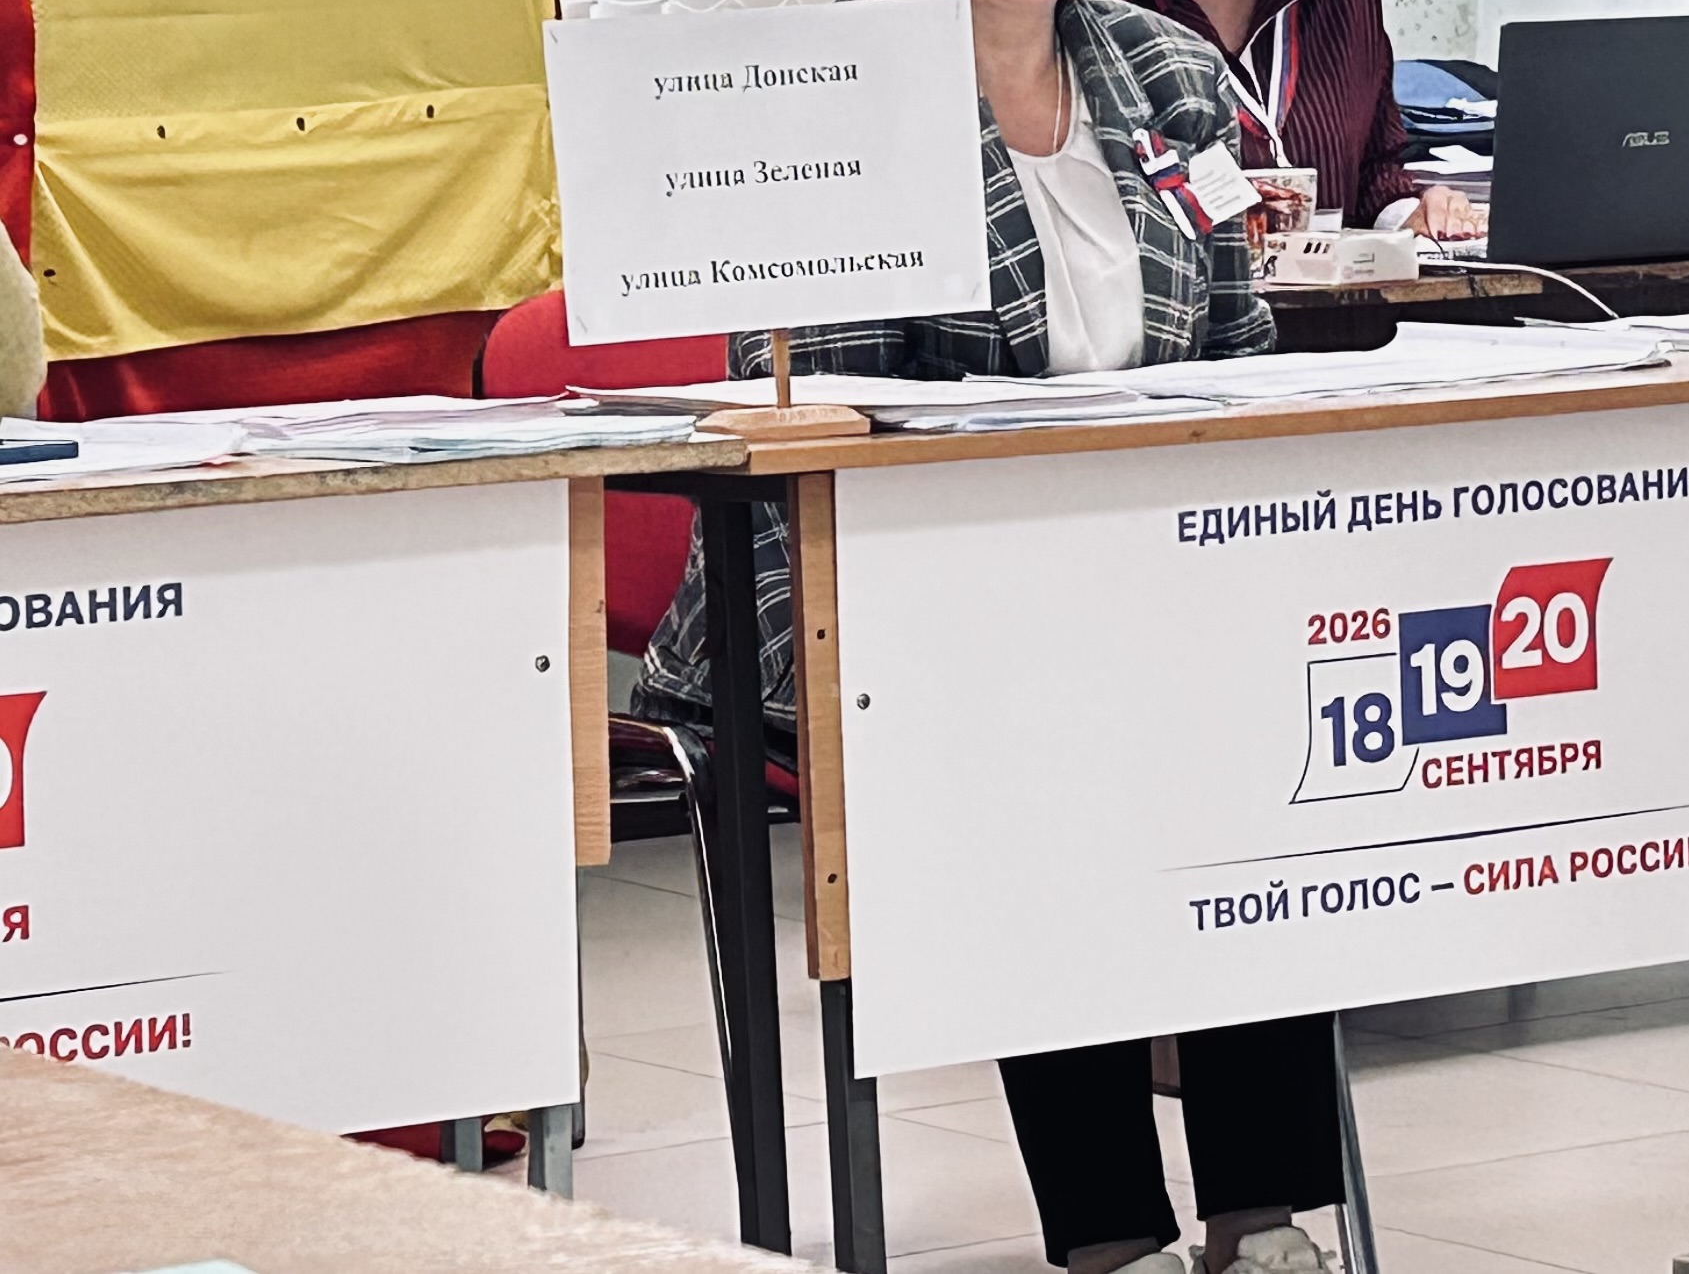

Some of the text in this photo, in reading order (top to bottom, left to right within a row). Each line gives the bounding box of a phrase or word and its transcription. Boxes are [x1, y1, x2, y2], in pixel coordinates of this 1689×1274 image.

[654, 64, 858, 100] улица Донская
[665, 160, 861, 197] улица Зеленая
[621, 251, 924, 297] улица Комсомольская
[1177, 489, 1336, 547] ЕДИНЫЙ
[1347, 489, 1443, 534] ДЕНЬ
[1307, 607, 1391, 646] 2026
[1320, 592, 1590, 767] 18 19 20
[1420, 739, 1602, 789] СЕНТЯБРЯ
[1189, 879, 1290, 931] ТВОЙ
[1301, 872, 1421, 918] ГОЛОС
[1463, 854, 1560, 895] СИЛА
[0, 1012, 192, 1062] ОССИИ!
